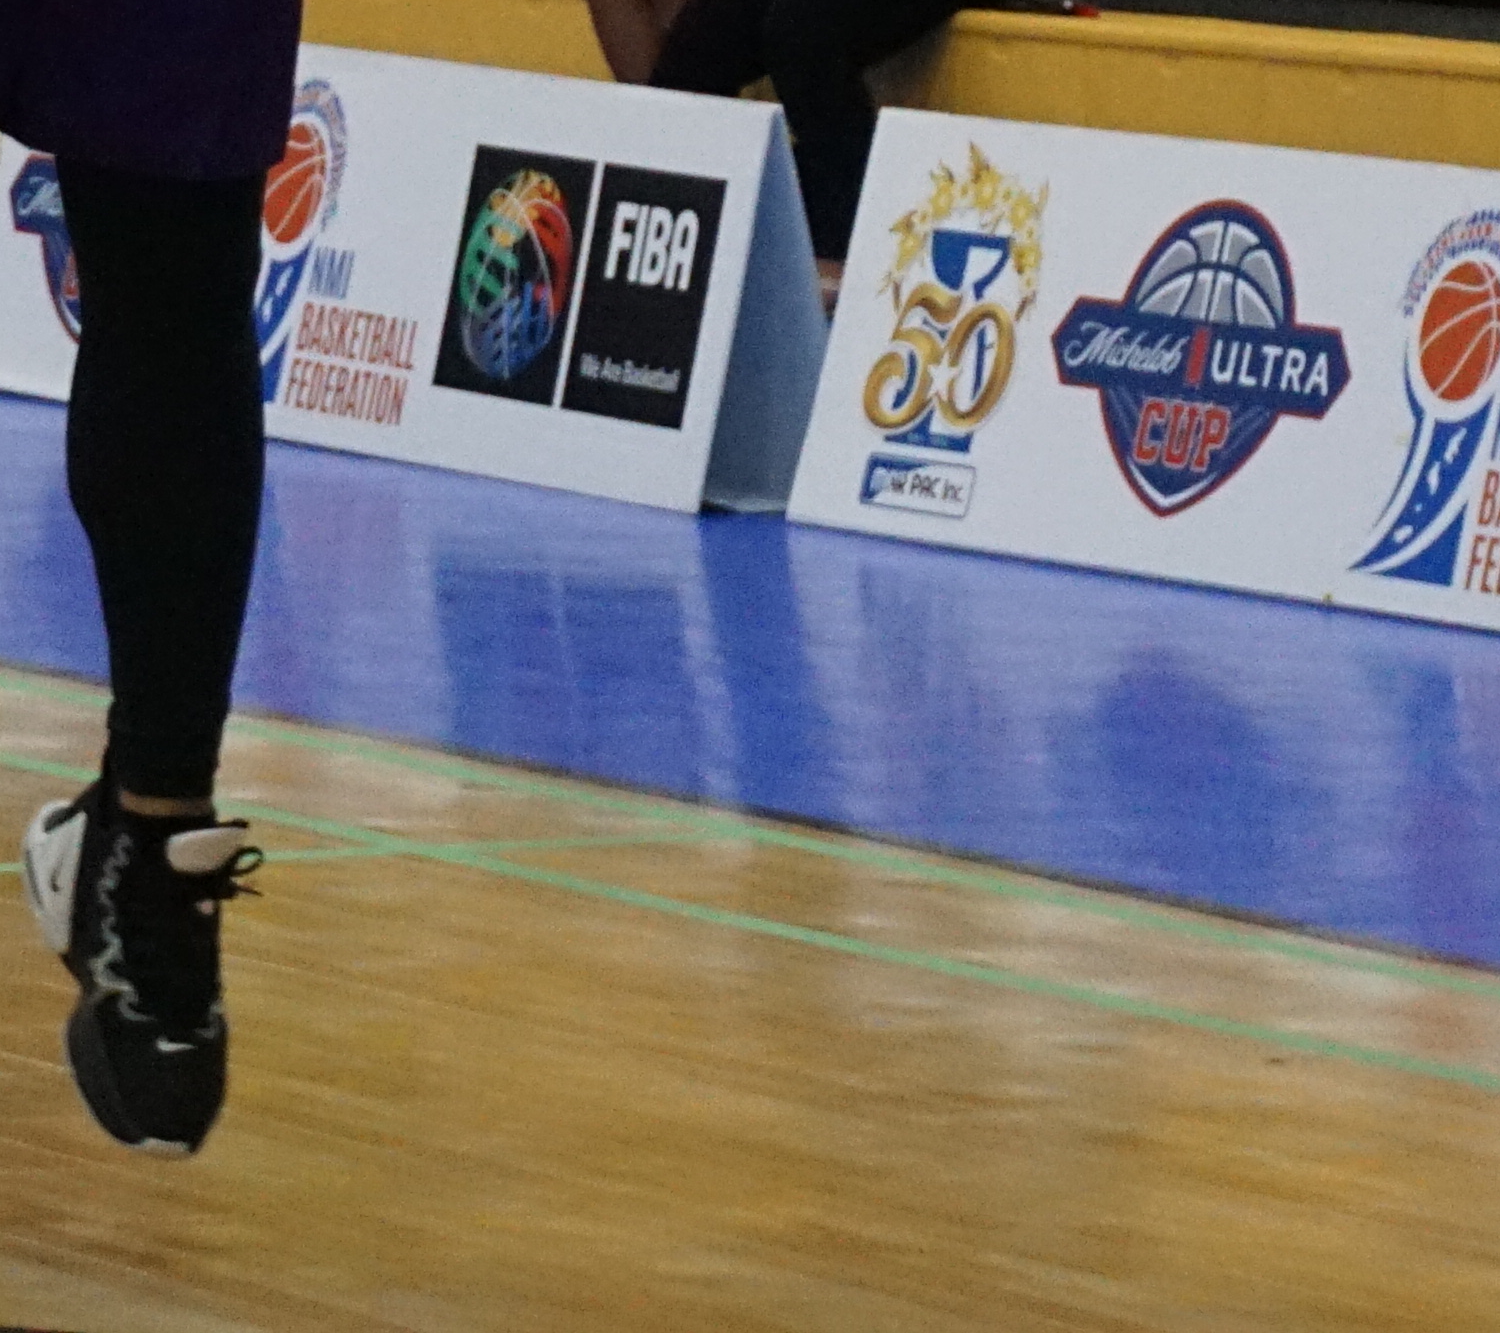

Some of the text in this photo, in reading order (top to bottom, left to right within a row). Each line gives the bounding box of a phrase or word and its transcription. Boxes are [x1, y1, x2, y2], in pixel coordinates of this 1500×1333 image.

[604, 201, 699, 292] FIBA
[296, 302, 418, 372] BASKETBALL
[863, 282, 1016, 430] 50
[1064, 320, 1329, 397] Michelob ULTRA
[284, 359, 409, 428] FEDERATION
[1132, 396, 1232, 473] CUP
